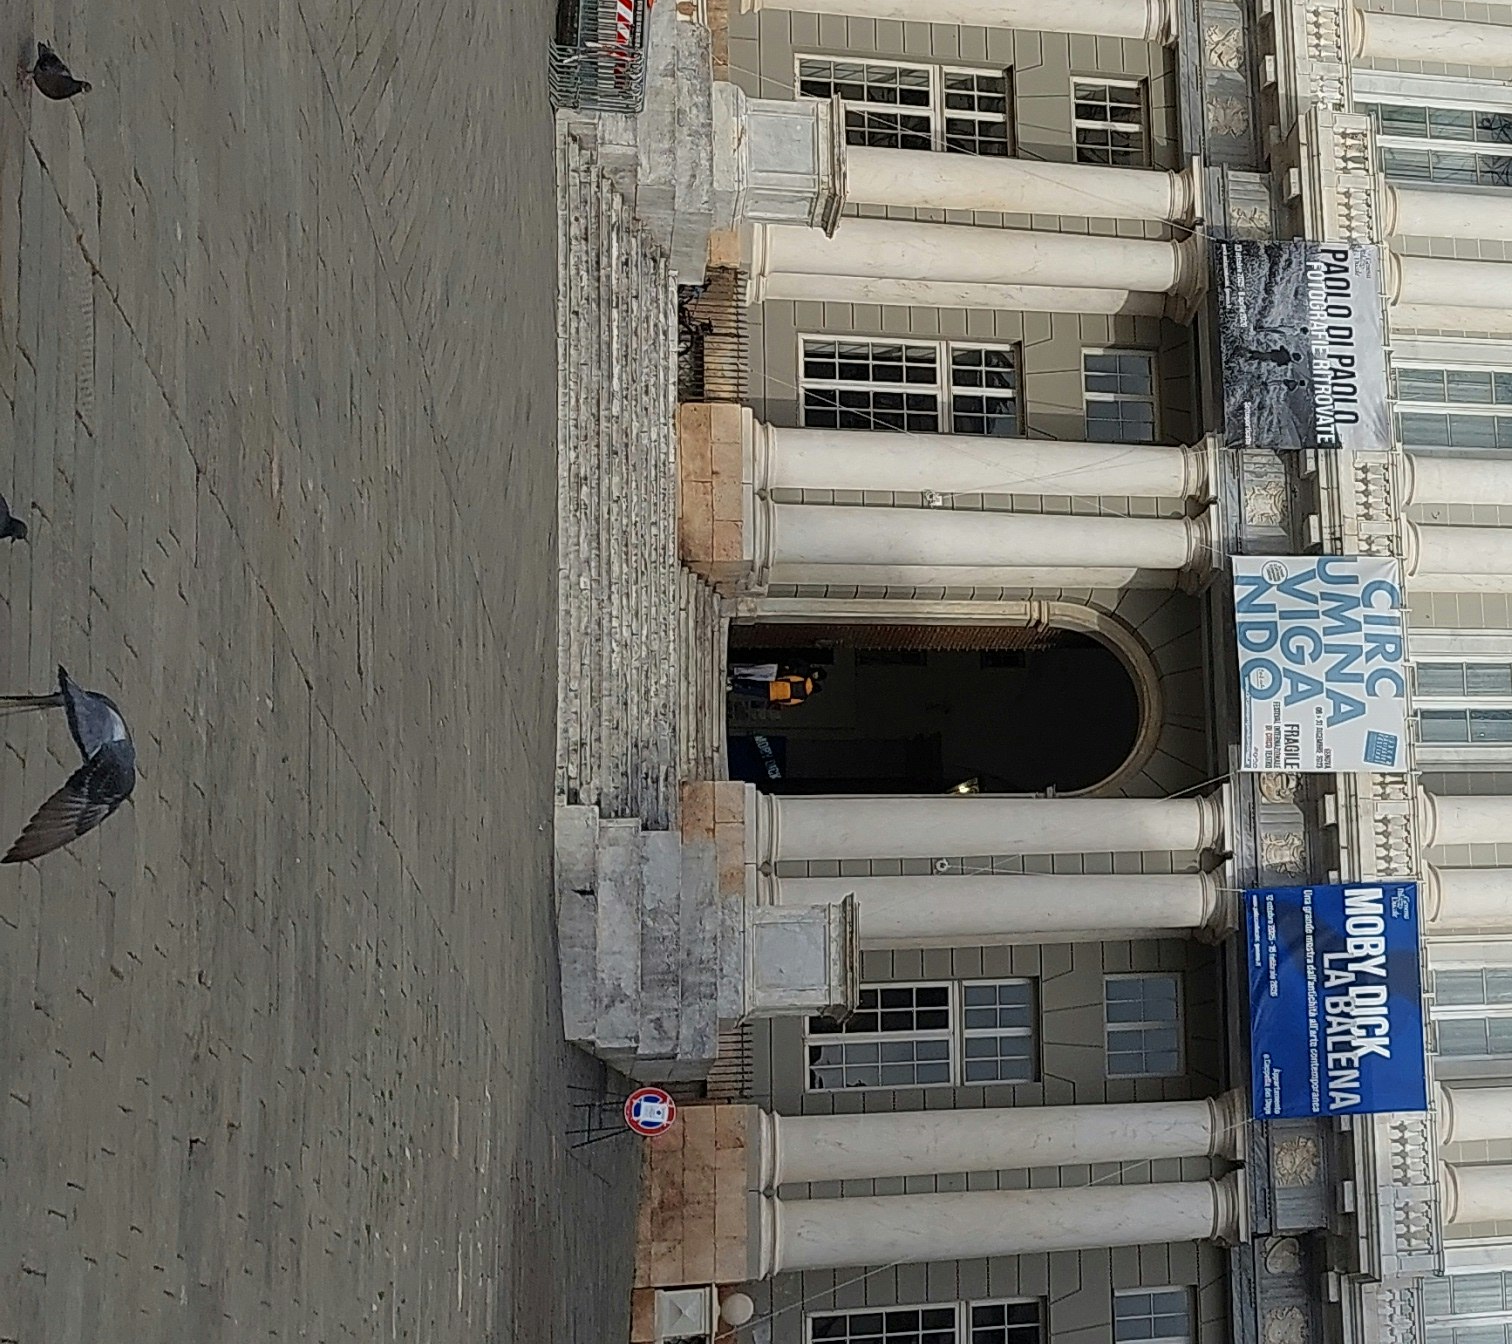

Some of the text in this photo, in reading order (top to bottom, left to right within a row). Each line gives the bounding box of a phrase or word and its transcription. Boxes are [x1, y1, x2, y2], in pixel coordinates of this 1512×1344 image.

[1306, 261, 1336, 444] FOTOGRAFIE RITROVATE
[1319, 249, 1360, 424] PAOLO DI PAOLO
[1233, 575, 1283, 702] NDO
[1276, 568, 1324, 707] VIGA
[1317, 557, 1366, 728] UMNA
[1361, 580, 1404, 698] CIRC
[1273, 701, 1281, 769] FESTIVAL INTERNAZIONALE
[1284, 724, 1300, 769] FRAGILE
[1302, 906, 1315, 933] grande
[1303, 889, 1313, 905] Una
[1305, 935, 1315, 963] mostra
[1323, 952, 1361, 1111] LA BALENA
[1344, 888, 1391, 1059] MOBY DICK
[1309, 1048, 1320, 1113] contemporanea
